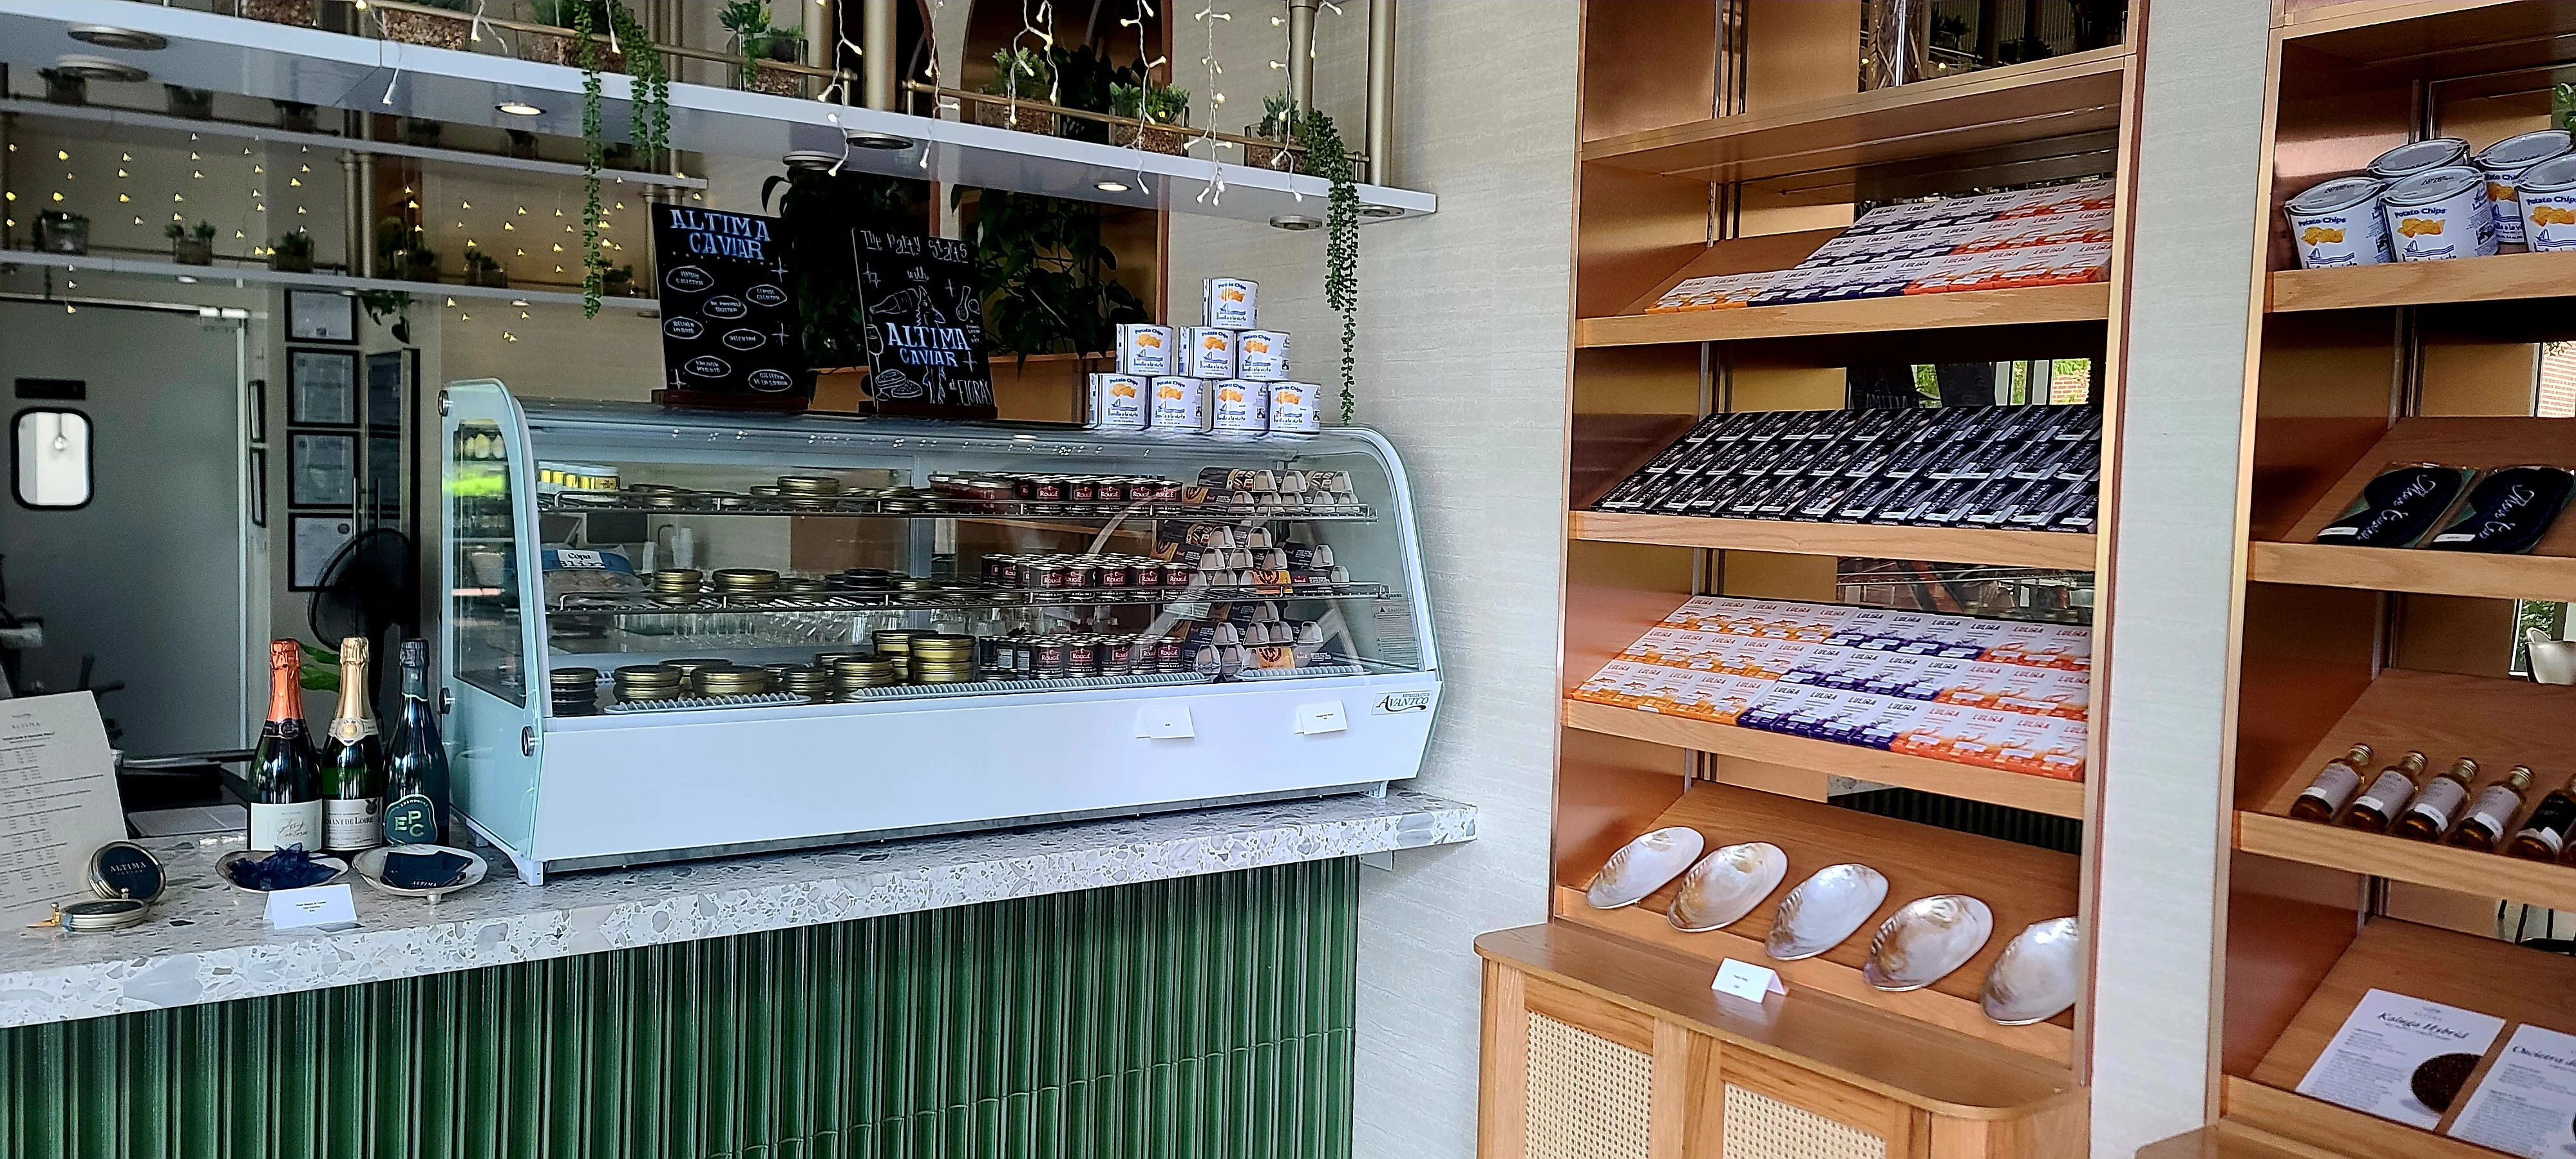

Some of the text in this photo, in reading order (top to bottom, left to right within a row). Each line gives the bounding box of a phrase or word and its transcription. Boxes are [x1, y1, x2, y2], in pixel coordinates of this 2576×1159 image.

[2394, 209, 2419, 219] Potato
[669, 209, 772, 241] ALTIMA
[689, 232, 765, 260] CAVIAR
[860, 230, 969, 264] The Party Starts
[907, 266, 929, 282] with
[886, 322, 972, 351] ALTIMA
[900, 348, 959, 368] CAVIAR
[1376, 695, 1429, 711] AVANTCO
[110, 862, 146, 872] ALTIMA
